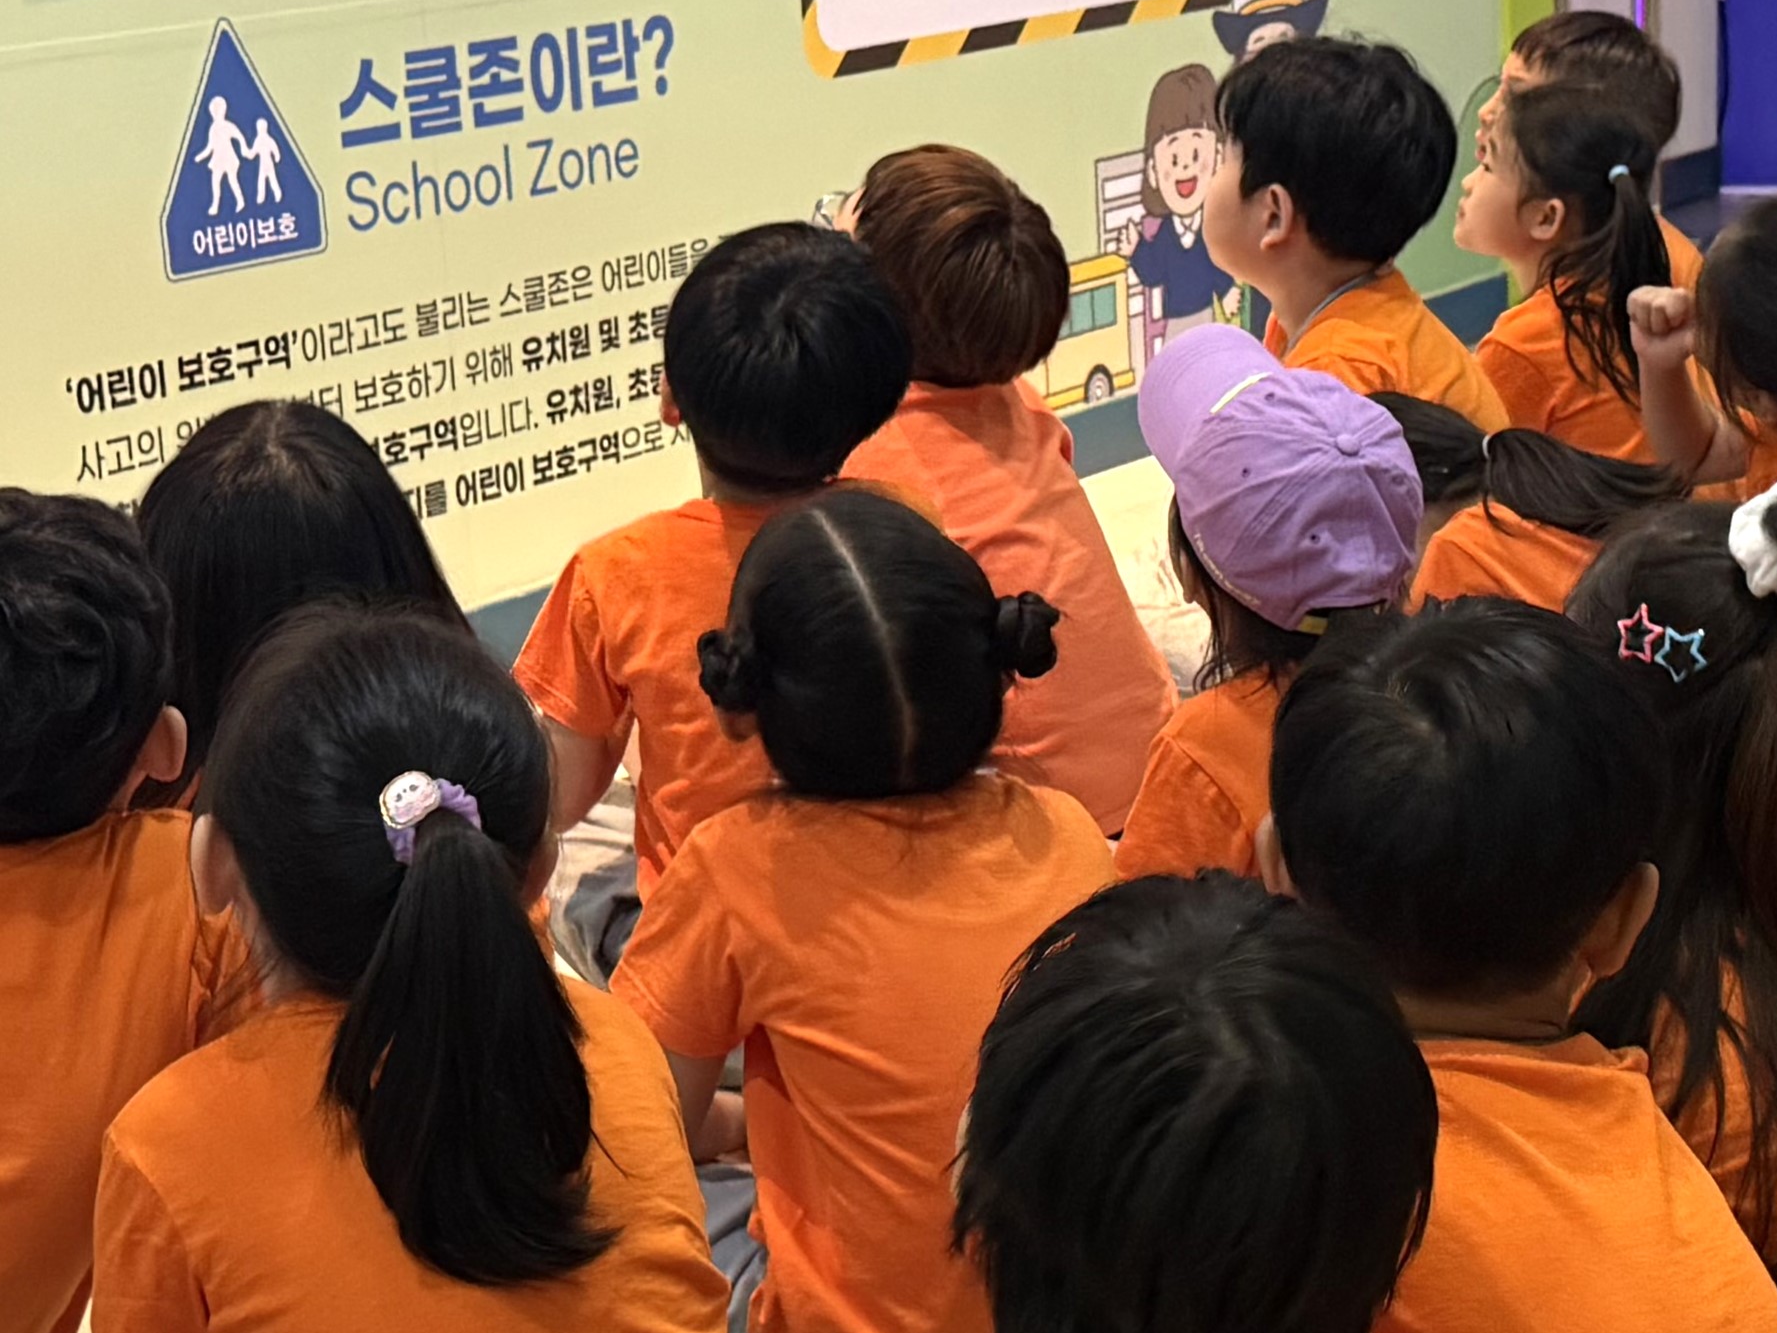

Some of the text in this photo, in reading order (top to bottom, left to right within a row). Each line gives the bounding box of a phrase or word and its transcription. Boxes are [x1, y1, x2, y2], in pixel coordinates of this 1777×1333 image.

[338, 14, 676, 149] 스쿨존이란?
[346, 137, 640, 232] School Zone
[192, 212, 299, 257] 어린이보호
[416, 292, 491, 339] 불리는
[499, 264, 594, 318] 스쿨존은
[76, 426, 166, 483] 사고의
[354, 355, 457, 414] 보호하기
[465, 342, 514, 386] 위해
[521, 323, 592, 373] 유치원
[598, 316, 621, 354] 및
[454, 457, 525, 507] 어린이
[532, 419, 665, 487] 보호구역으로
